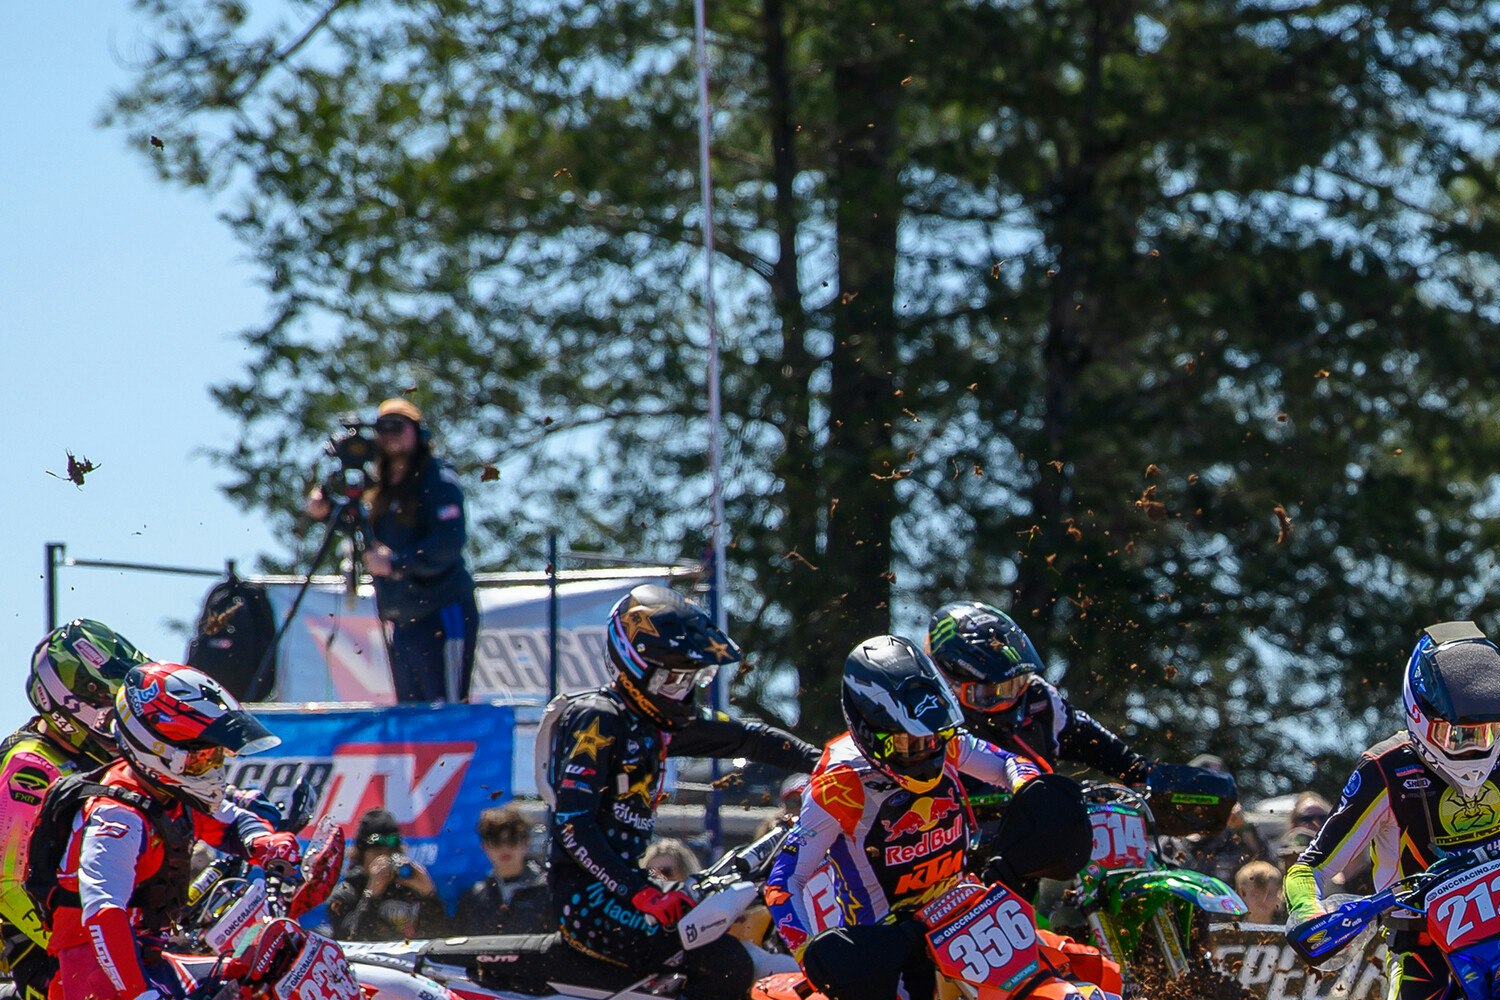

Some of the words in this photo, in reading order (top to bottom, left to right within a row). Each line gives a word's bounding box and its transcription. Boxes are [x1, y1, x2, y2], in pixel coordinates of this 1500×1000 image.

[51, 711, 79, 735] 347
[14, 792, 35, 803] FXR
[886, 832, 929, 867] Red
[930, 813, 963, 851] Bull
[1091, 813, 1148, 860] 514
[1436, 832, 1474, 844] MOOSE
[894, 849, 963, 896] KTM
[948, 900, 1036, 984] 356
